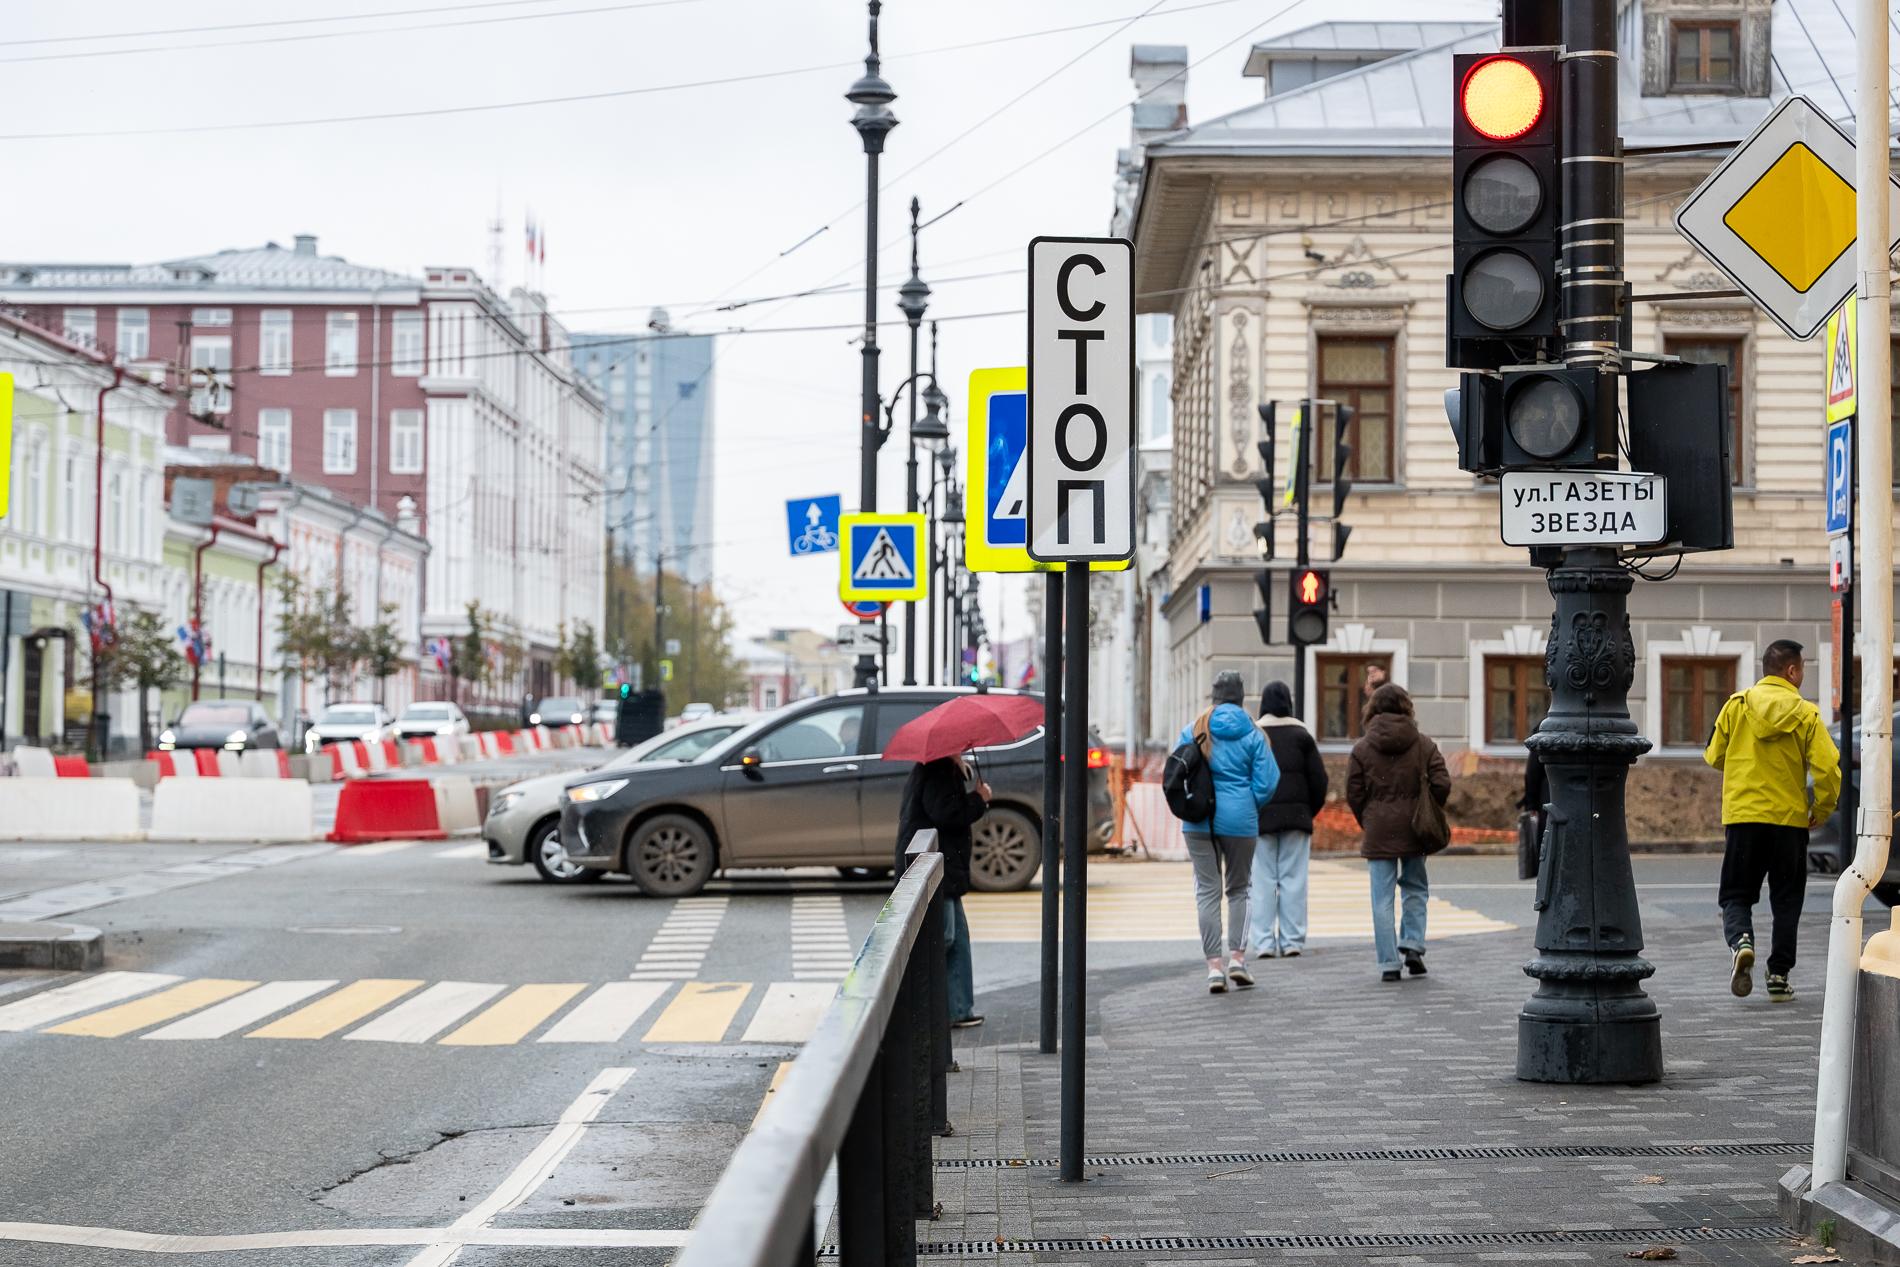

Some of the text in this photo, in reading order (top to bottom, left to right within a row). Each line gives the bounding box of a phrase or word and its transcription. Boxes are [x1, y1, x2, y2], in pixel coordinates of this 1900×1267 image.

[1054, 253, 1108, 545] СТОП
[1513, 481, 1654, 508] ул.ГАЗЕТЫ
[1531, 511, 1637, 535] ЗВЕЗДА
